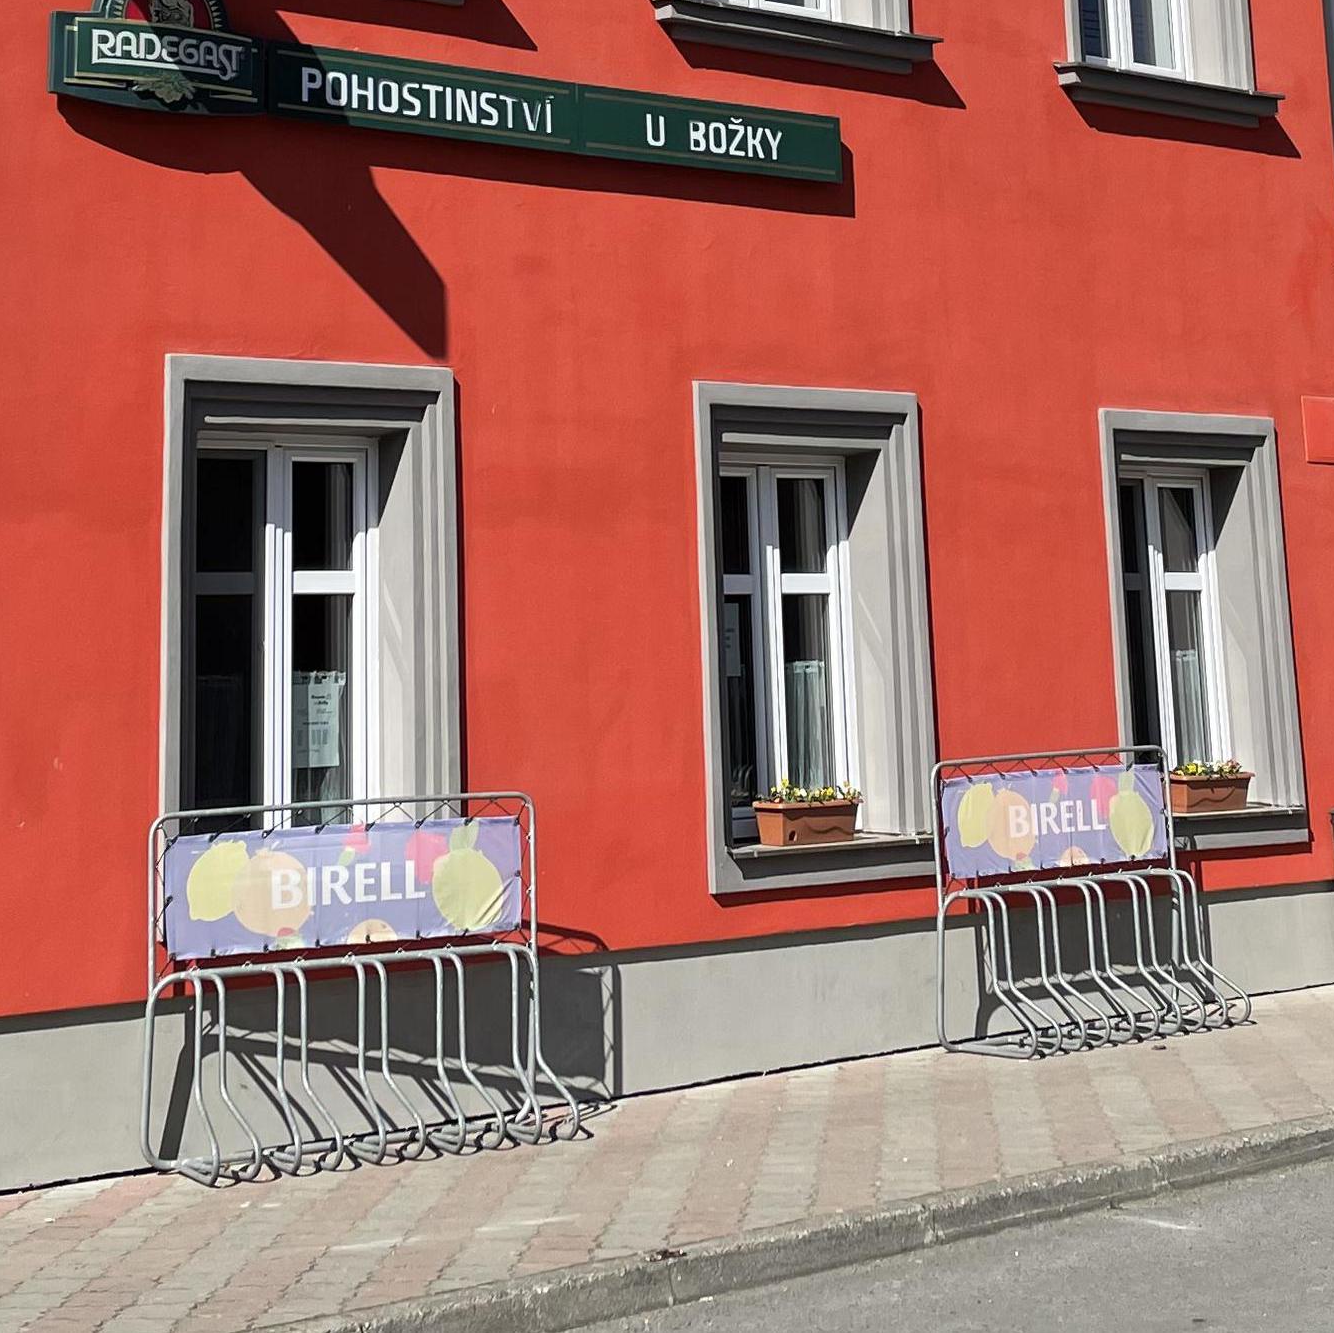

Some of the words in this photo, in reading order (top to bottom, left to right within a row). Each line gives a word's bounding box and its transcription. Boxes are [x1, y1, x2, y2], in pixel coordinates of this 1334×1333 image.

[91, 28, 244, 82] RADEGAST
[301, 66, 555, 134] POHOSTINSTVÍ
[645, 113, 666, 147] U
[689, 117, 783, 161] BOŽKY
[1008, 798, 1108, 839] BIRELL
[270, 859, 426, 911] BIRELL
